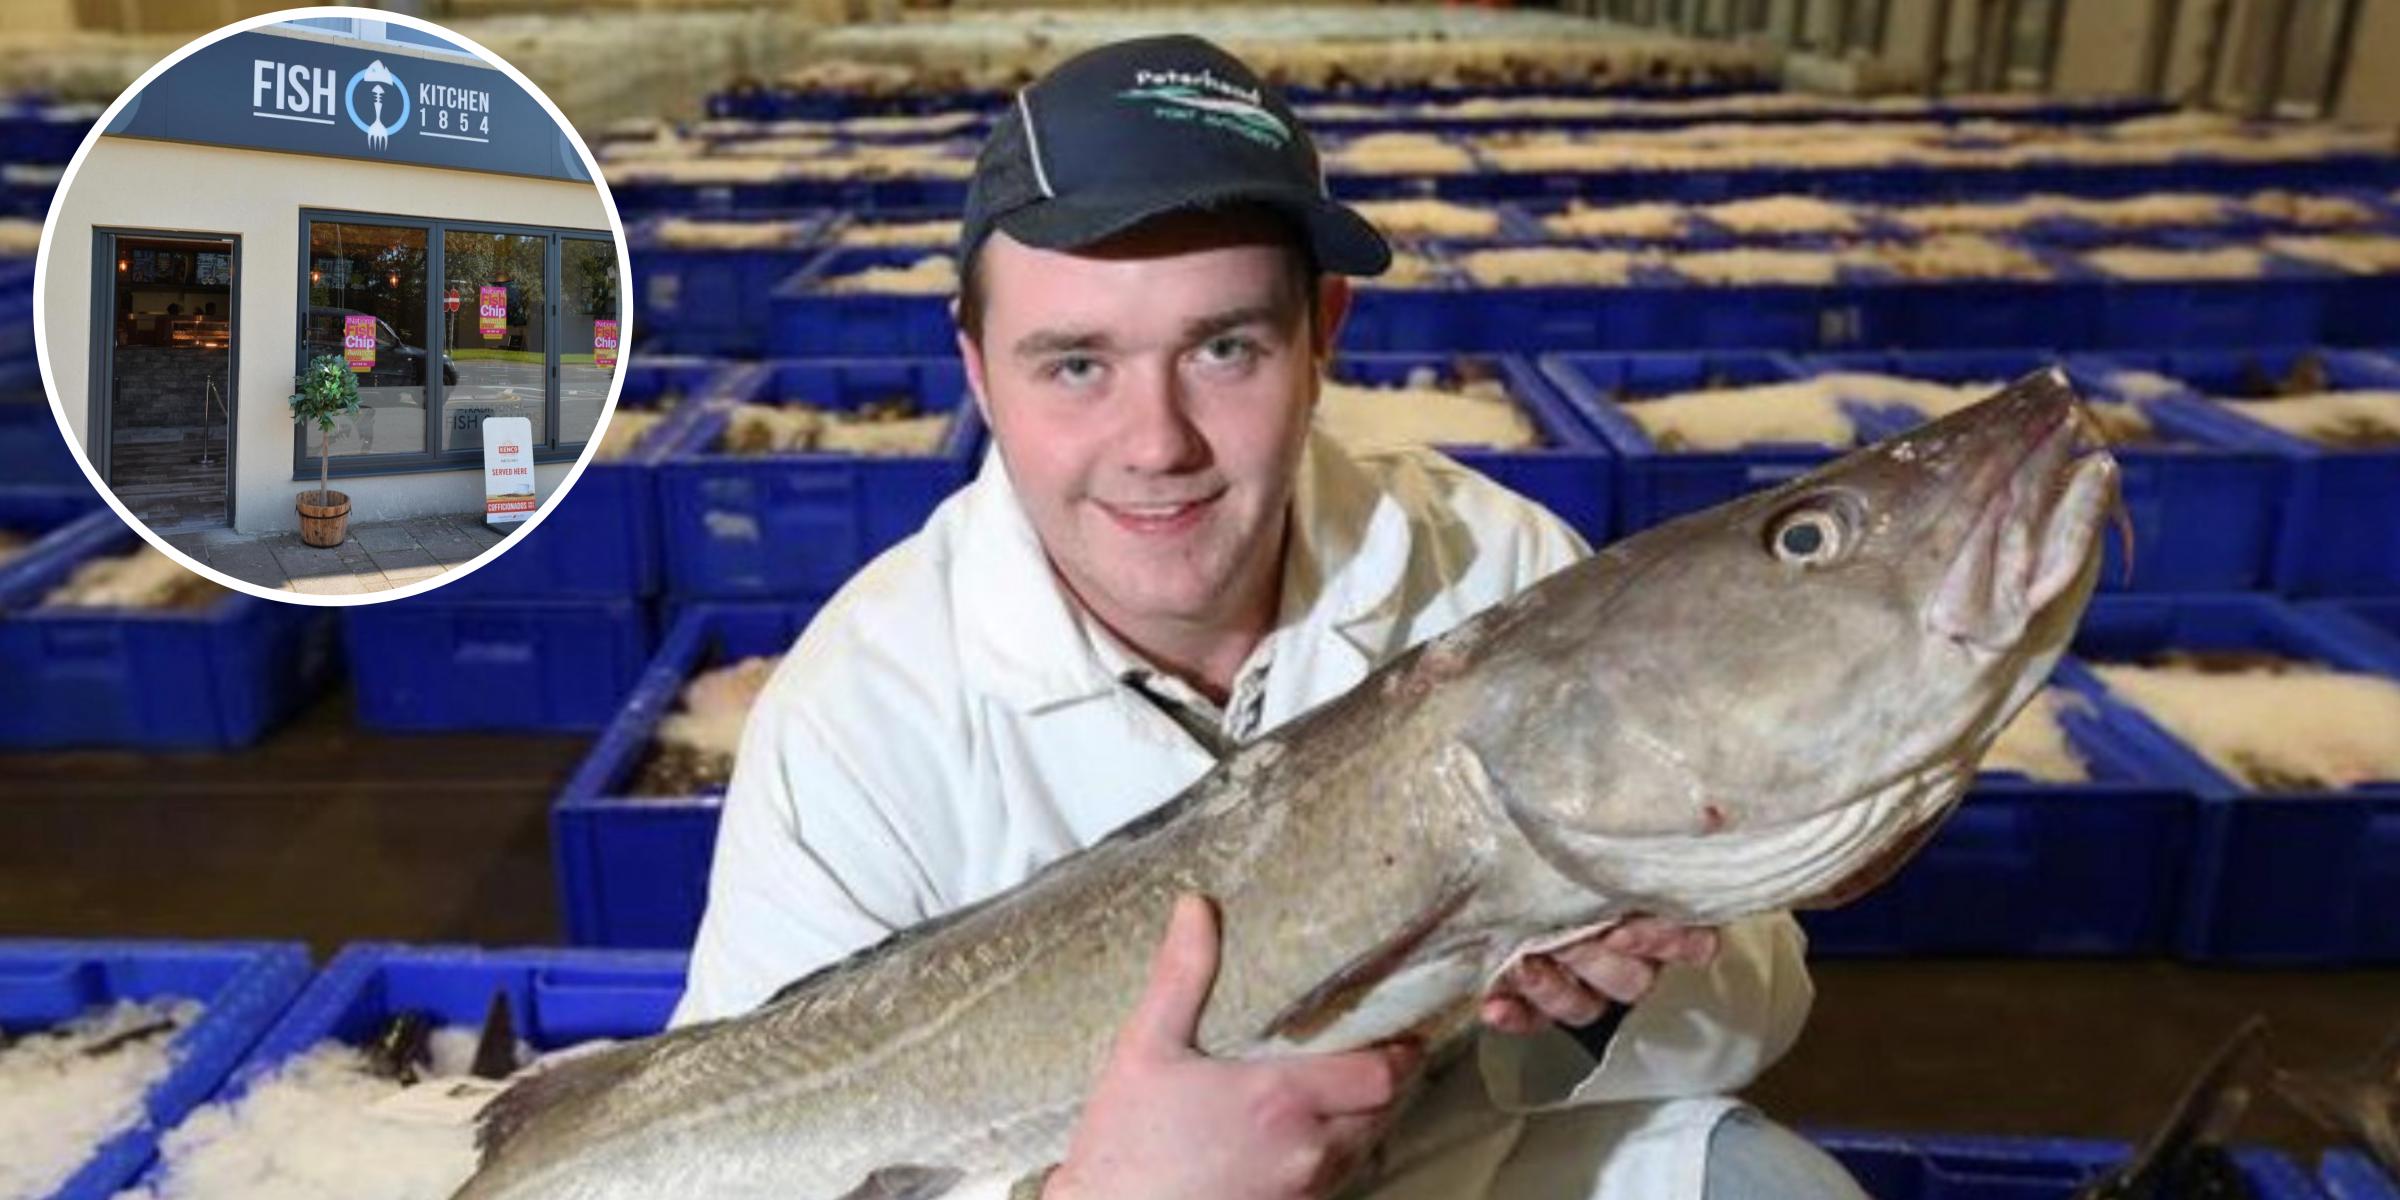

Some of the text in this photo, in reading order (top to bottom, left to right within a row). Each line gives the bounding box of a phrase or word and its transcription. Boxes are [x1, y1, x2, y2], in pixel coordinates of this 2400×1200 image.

[253, 59, 336, 116] FISH
[1136, 68, 1262, 107] Peterhead
[419, 82, 490, 113] KITCHEN
[480, 304, 506, 319] Chip
[345, 335, 375, 350] Chip
[594, 336, 617, 350] Chip
[492, 467, 528, 476] SERVED HERE
